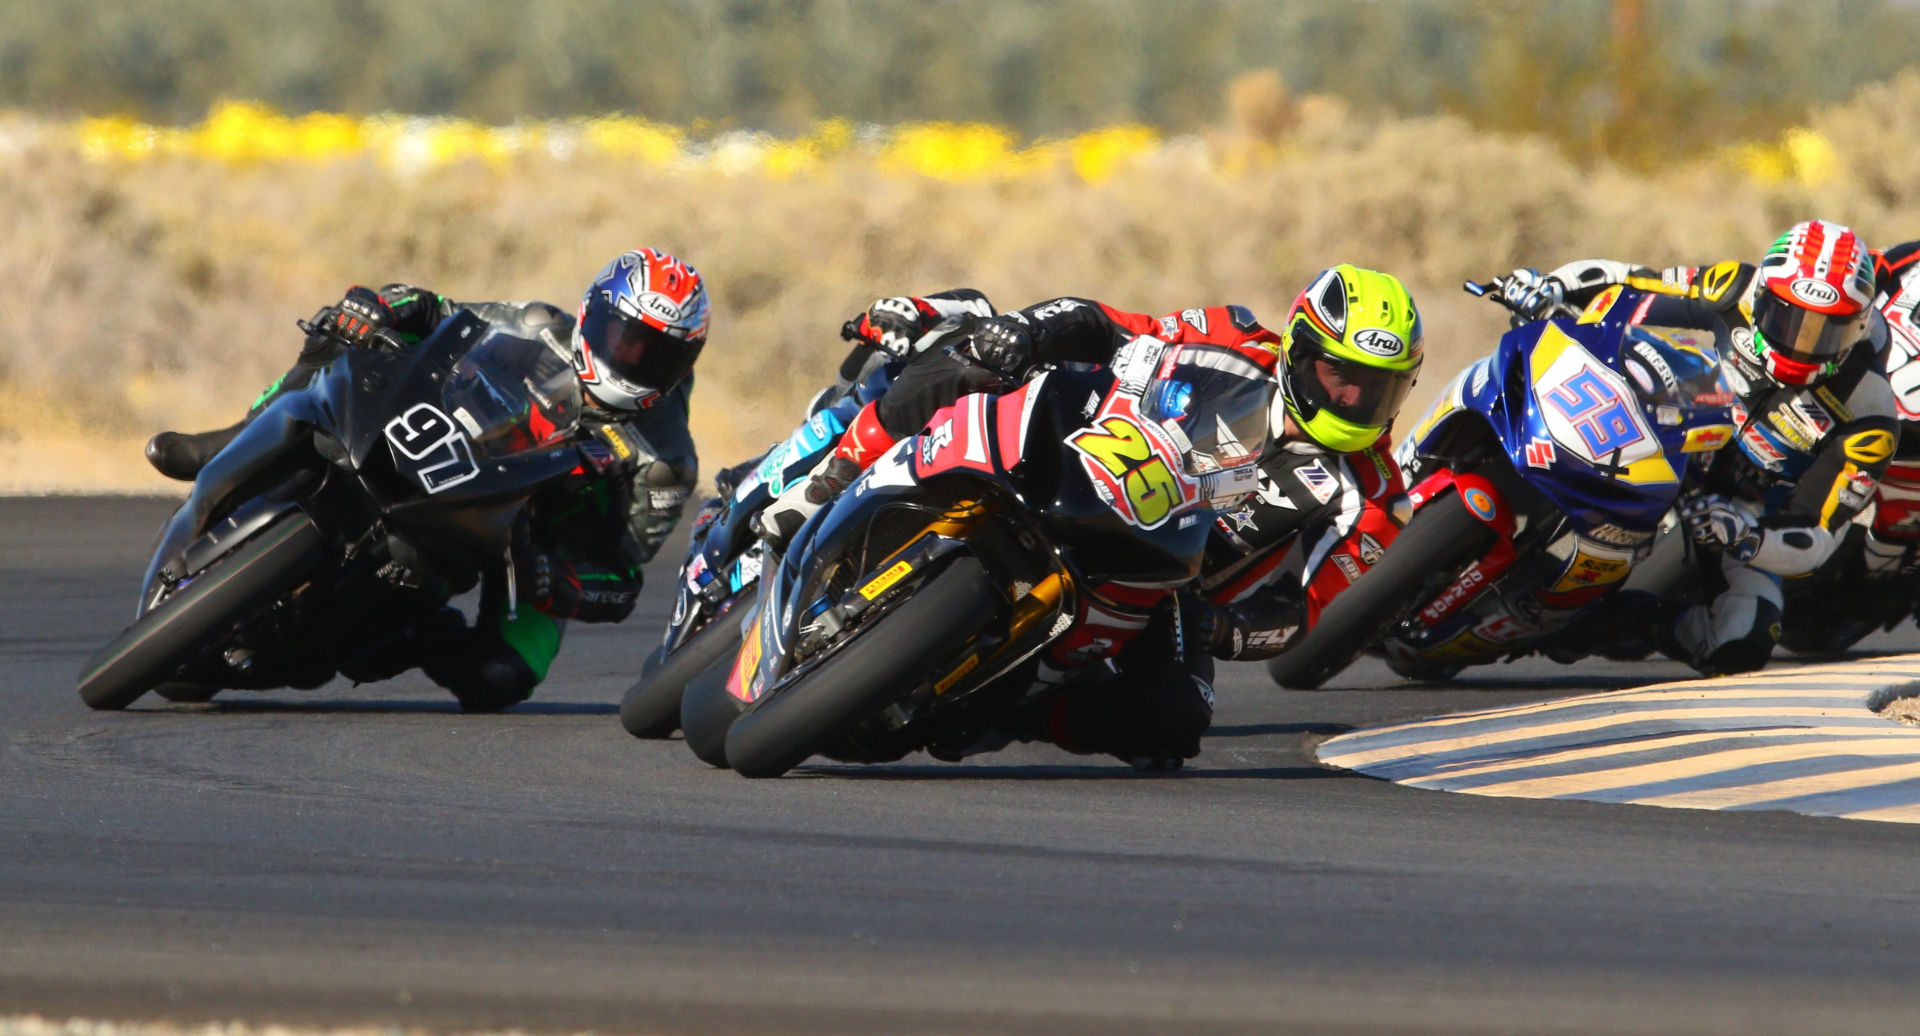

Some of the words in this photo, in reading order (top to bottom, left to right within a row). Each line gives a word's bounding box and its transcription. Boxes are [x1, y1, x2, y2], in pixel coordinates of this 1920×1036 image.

[646, 296, 680, 319] Arai
[1799, 282, 1835, 301] Arai
[1359, 331, 1400, 352] Arai
[1542, 364, 1646, 461] 59
[384, 402, 481, 495] 97
[1068, 417, 1184, 527] 25
[1424, 569, 1483, 619] DUNLOP
